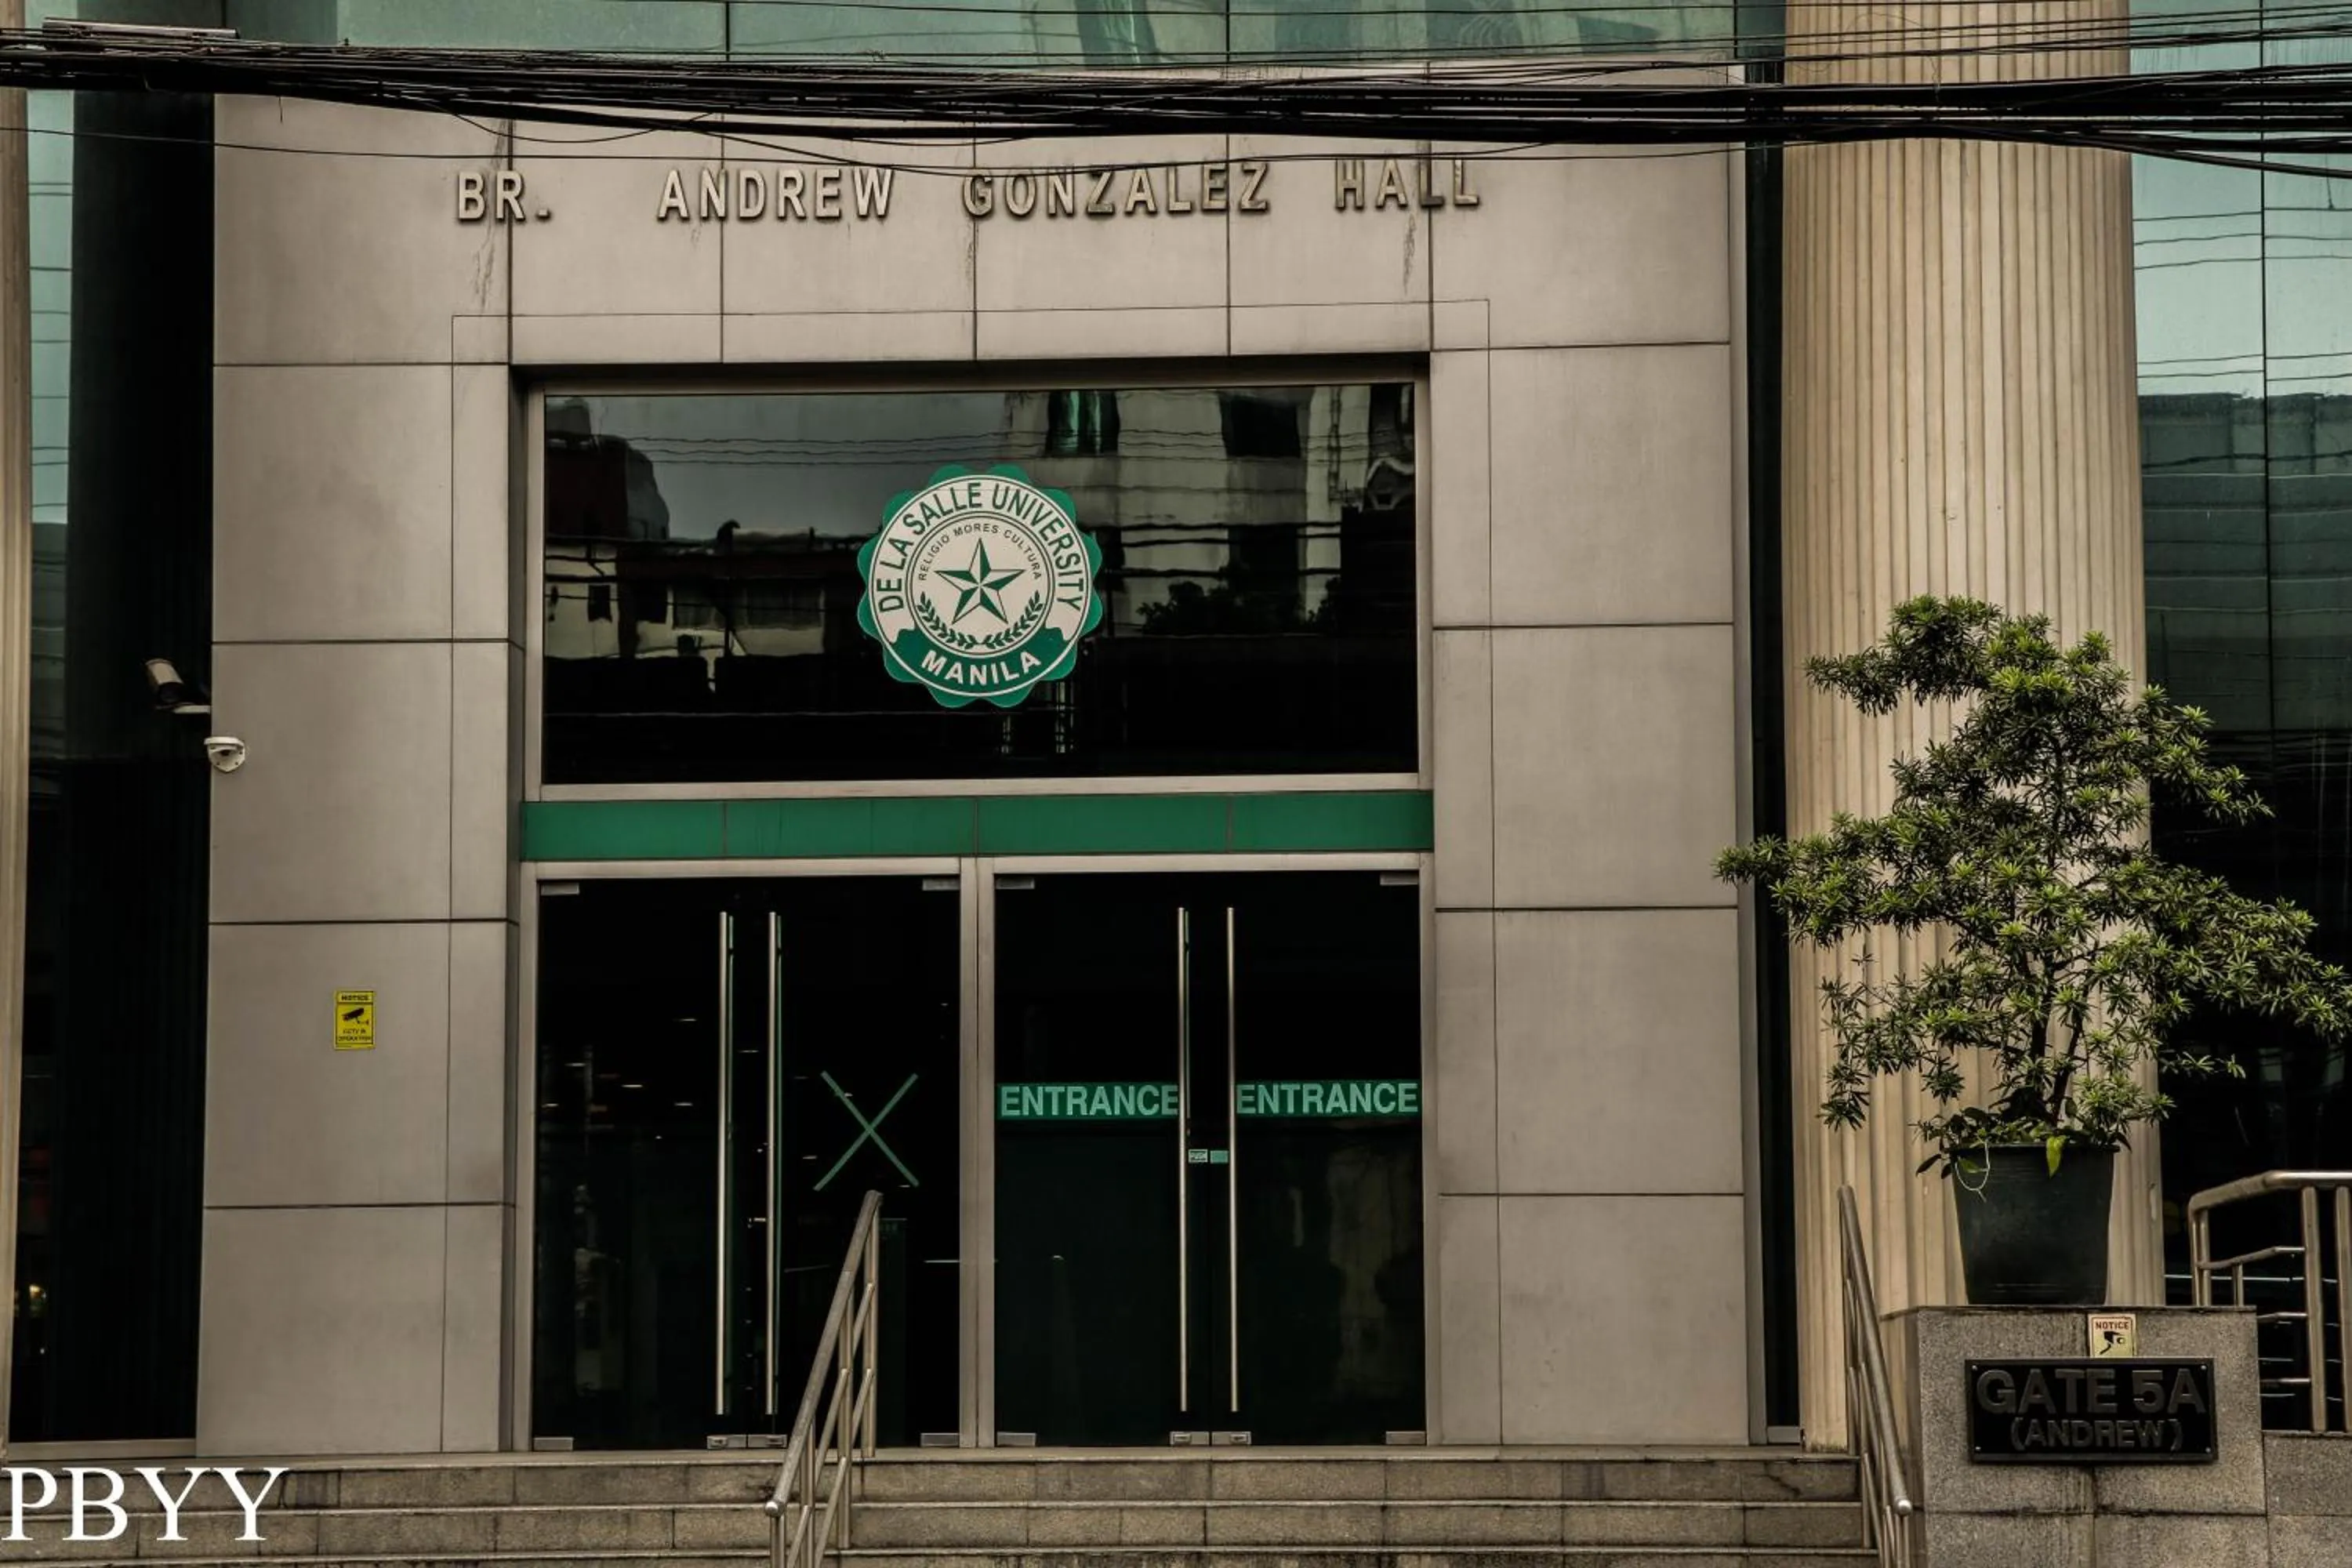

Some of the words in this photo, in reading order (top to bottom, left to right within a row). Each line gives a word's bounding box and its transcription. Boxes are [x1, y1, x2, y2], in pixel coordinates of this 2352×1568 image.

[457, 170, 552, 220] BR.
[656, 168, 895, 220] ANDREW
[961, 159, 1269, 217] GONZALEZ
[1334, 157, 1480, 210] HALL
[902, 482, 982, 535] SALLE
[879, 536, 913, 571] LA
[918, 535, 950, 581] RELIGIO
[953, 523, 999, 537] MORES
[1003, 529, 1041, 580] CULTURA
[991, 483, 1084, 612] UNIVERSITY
[876, 578, 904, 613] DE
[920, 650, 1041, 686] MANILA
[1000, 1084, 1178, 1116] ENTRANCE
[1236, 1082, 1418, 1114] ENTRANCE
[2095, 1320, 2129, 1330] NOTICE
[1976, 1368, 2118, 1414] GATE
[2131, 1368, 2206, 1414] 5A
[2010, 1416, 2183, 1451] (ANDREW)
